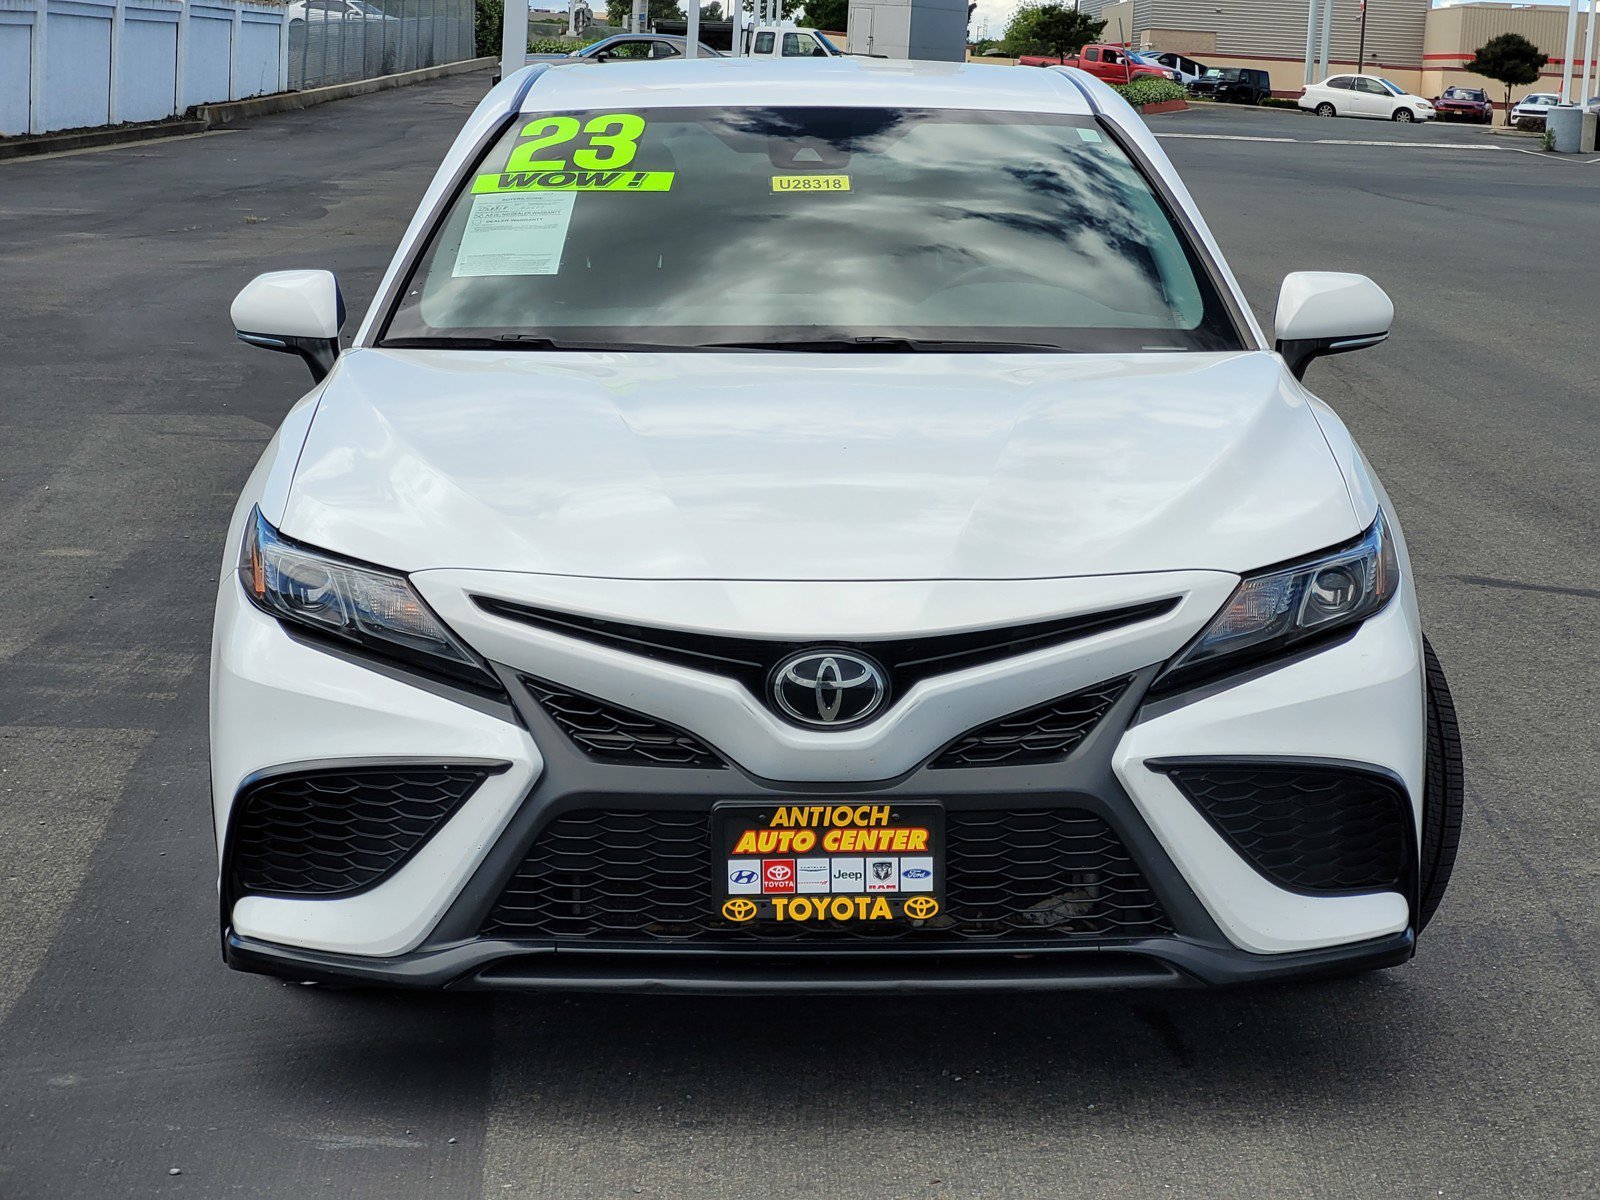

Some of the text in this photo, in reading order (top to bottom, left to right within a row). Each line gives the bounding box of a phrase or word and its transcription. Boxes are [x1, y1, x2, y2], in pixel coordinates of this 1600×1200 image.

[505, 114, 646, 172] 23
[779, 178, 842, 190] U28318
[769, 805, 891, 828] ANTIOCH
[732, 829, 930, 854] AUTO CENTER
[833, 869, 862, 881] Jeep
[771, 896, 893, 921] TOYOTA
